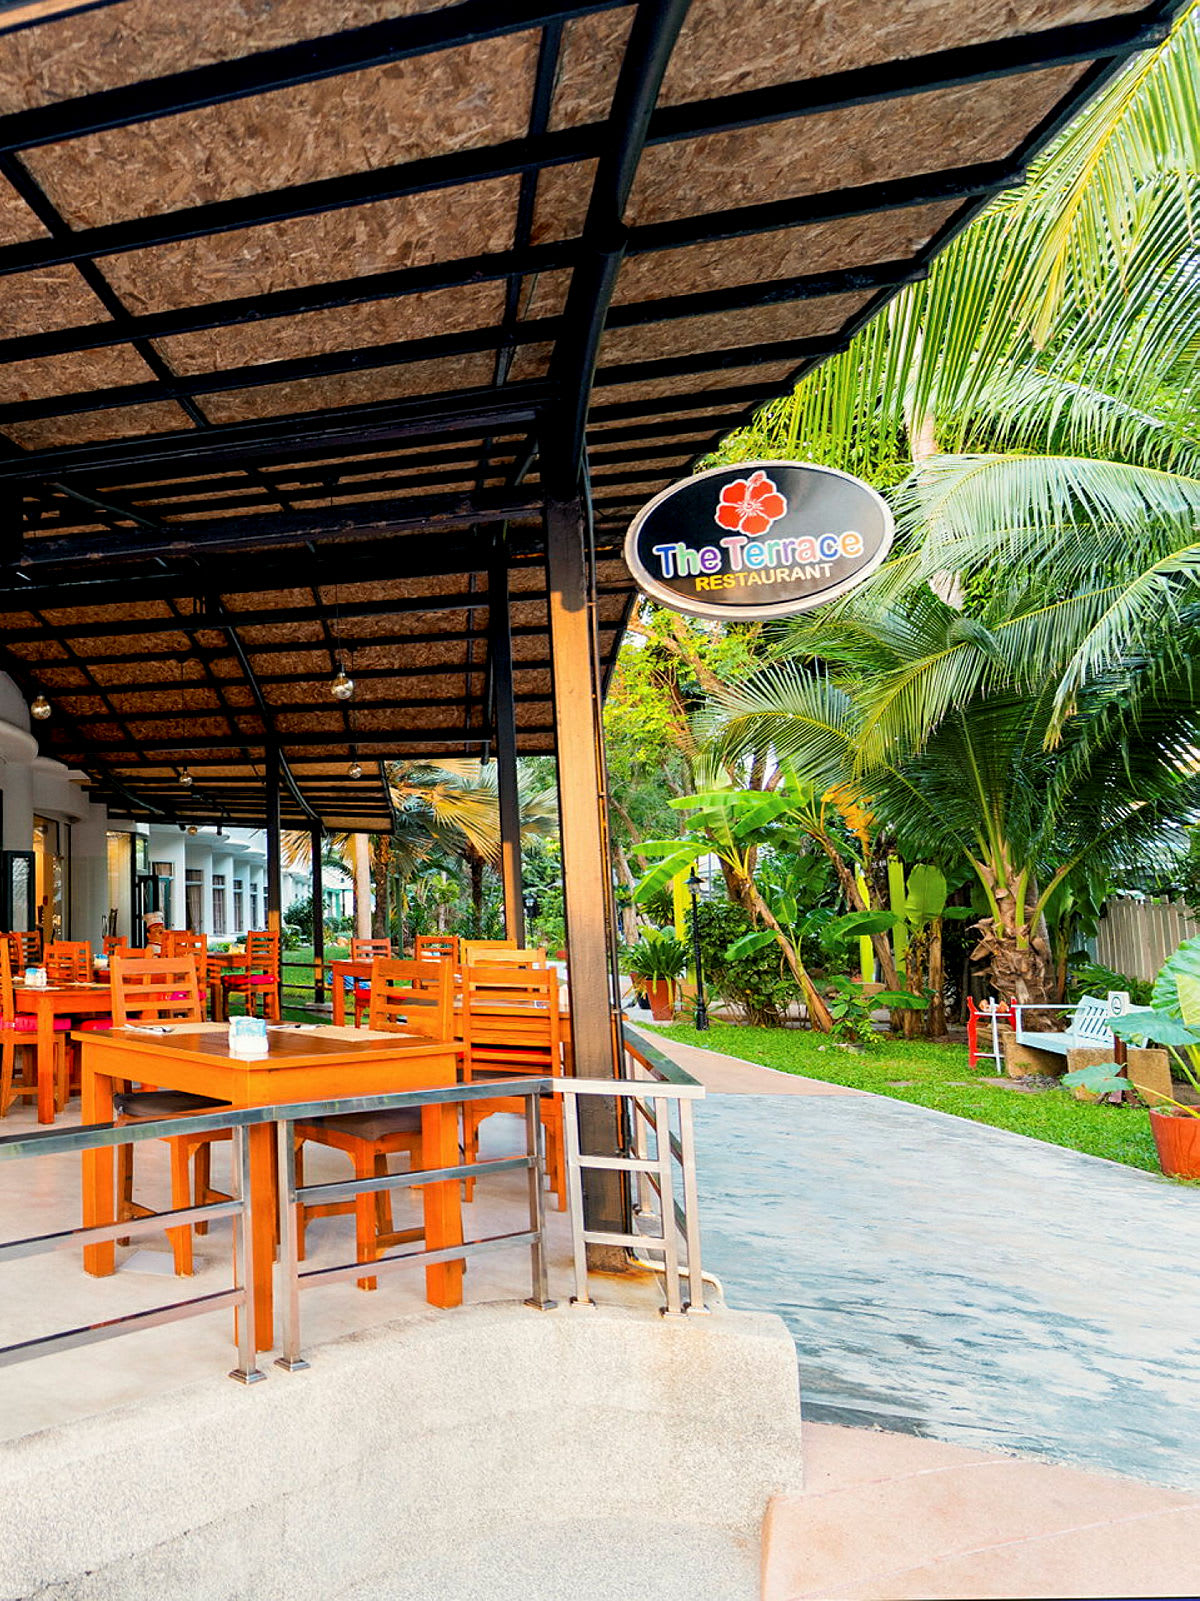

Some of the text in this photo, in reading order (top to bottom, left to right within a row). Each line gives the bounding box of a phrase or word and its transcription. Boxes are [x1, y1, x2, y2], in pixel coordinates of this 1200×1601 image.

[653, 531, 864, 579] The Terrace
[695, 563, 833, 592] RESTAURANT
